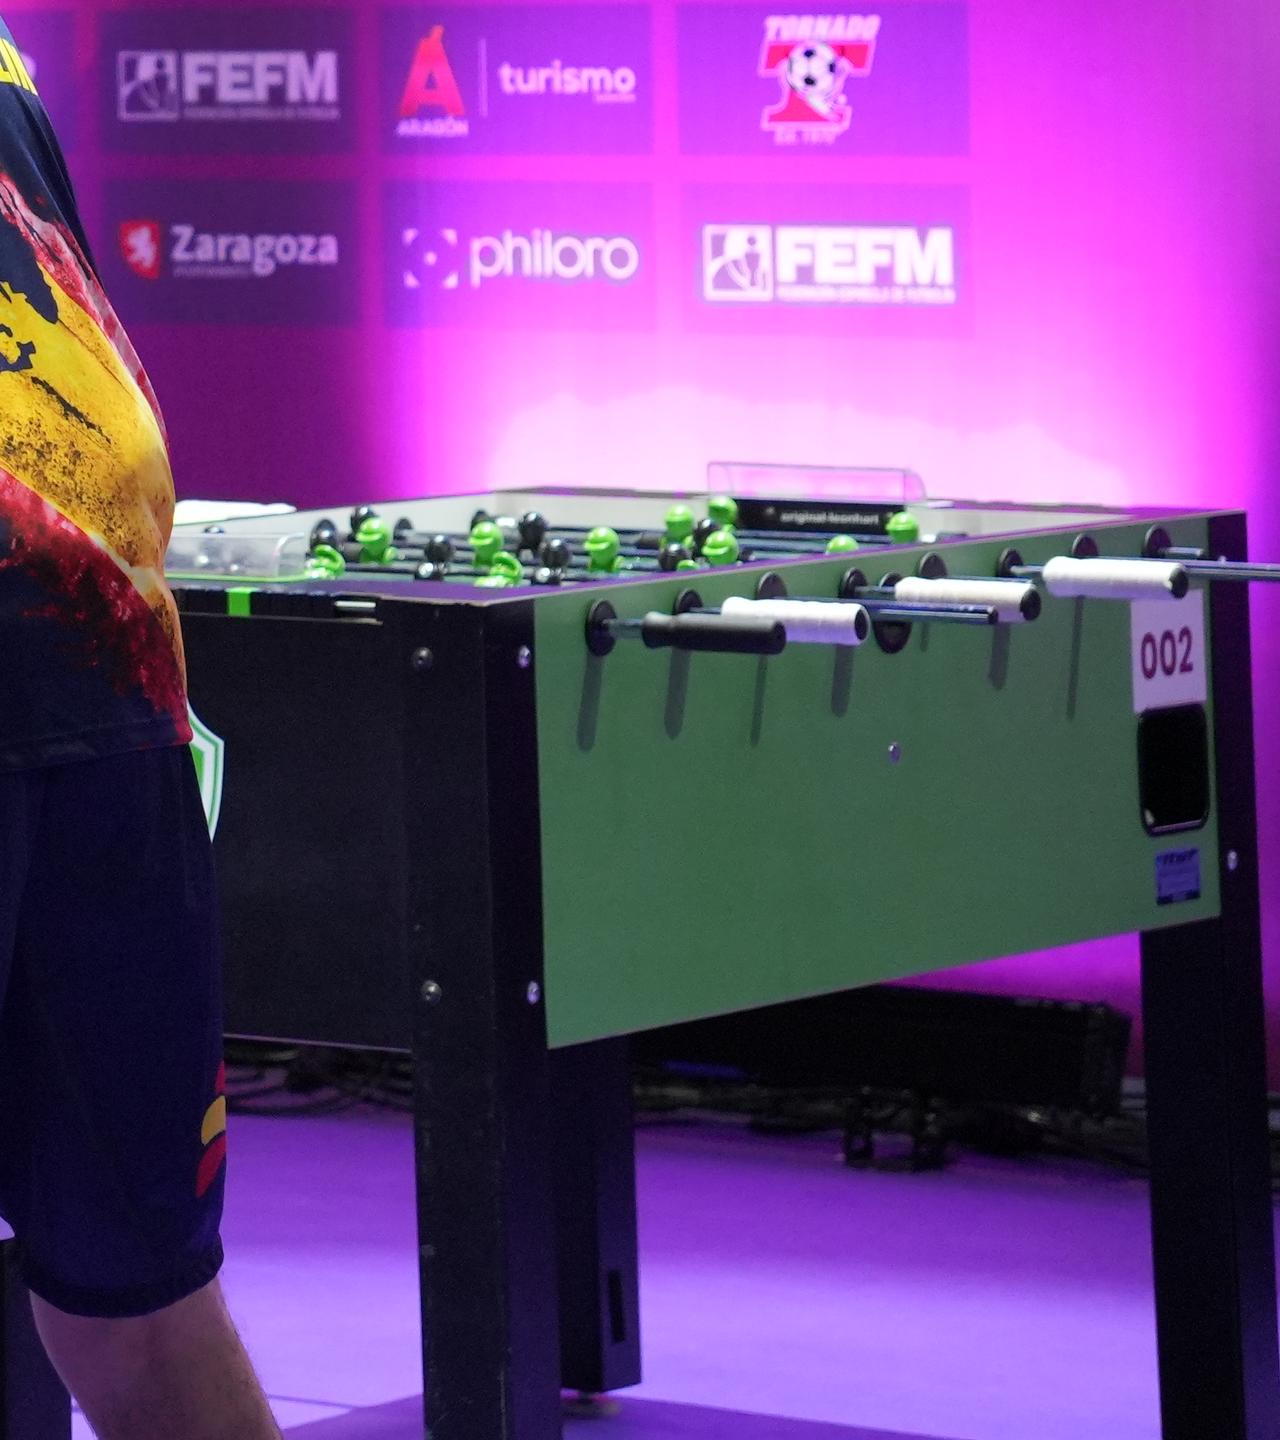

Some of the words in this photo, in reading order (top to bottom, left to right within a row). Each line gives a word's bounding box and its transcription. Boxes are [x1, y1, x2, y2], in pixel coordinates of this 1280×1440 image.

[183, 51, 338, 106] FEFM
[498, 59, 637, 97] turismo
[170, 223, 339, 277] Zaragoza
[470, 228, 641, 289] philoro
[775, 225, 954, 286] FEFM
[1140, 627, 1195, 681] 002
